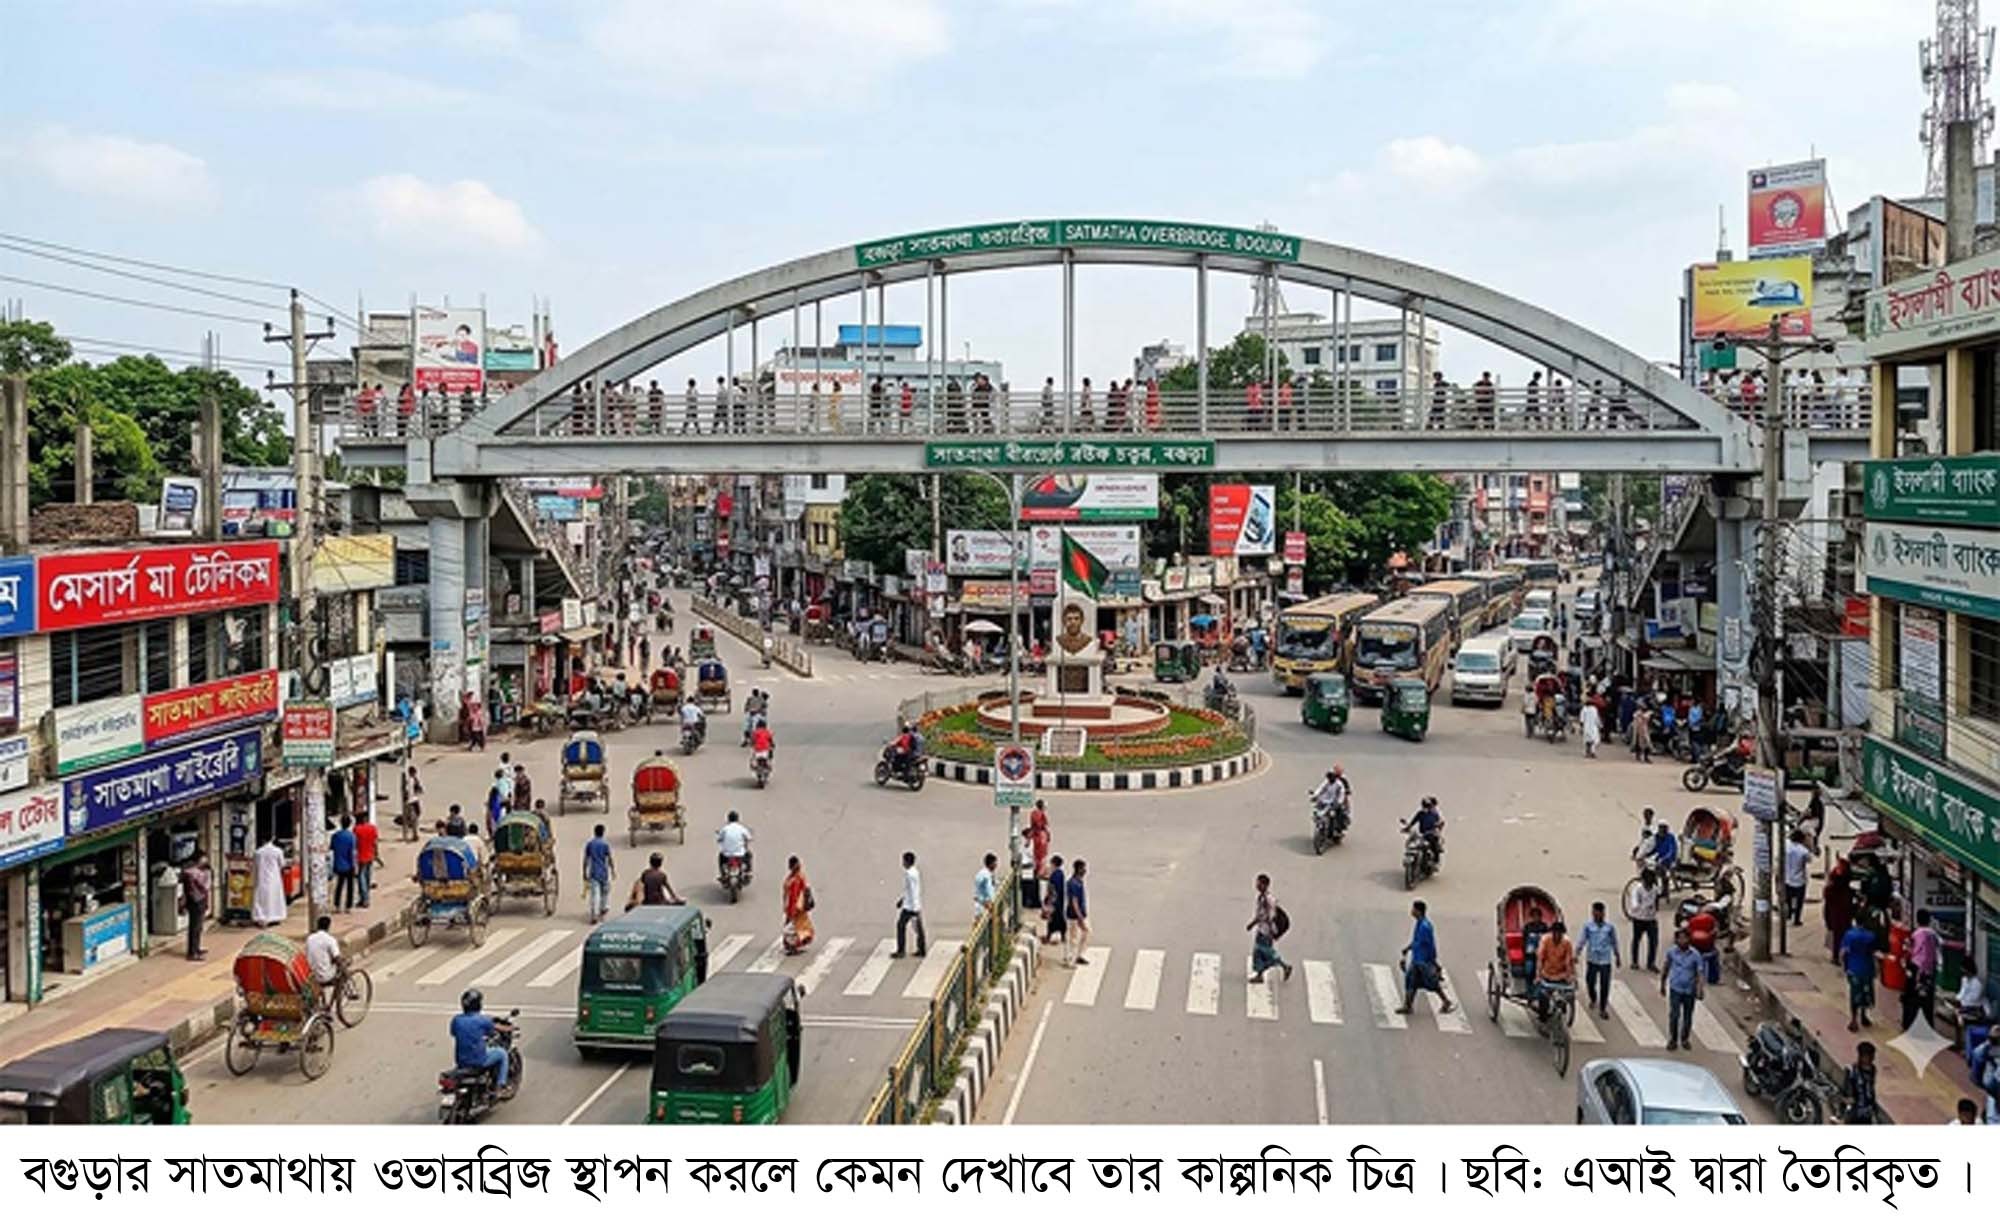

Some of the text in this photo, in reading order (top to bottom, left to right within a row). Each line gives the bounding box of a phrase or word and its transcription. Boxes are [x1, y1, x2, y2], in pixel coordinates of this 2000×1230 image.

[1065, 224, 1138, 242] SATMATHA
[49, 555, 141, 612] মেসার্স
[146, 562, 176, 599] মা
[184, 549, 272, 596] টেলিকম
